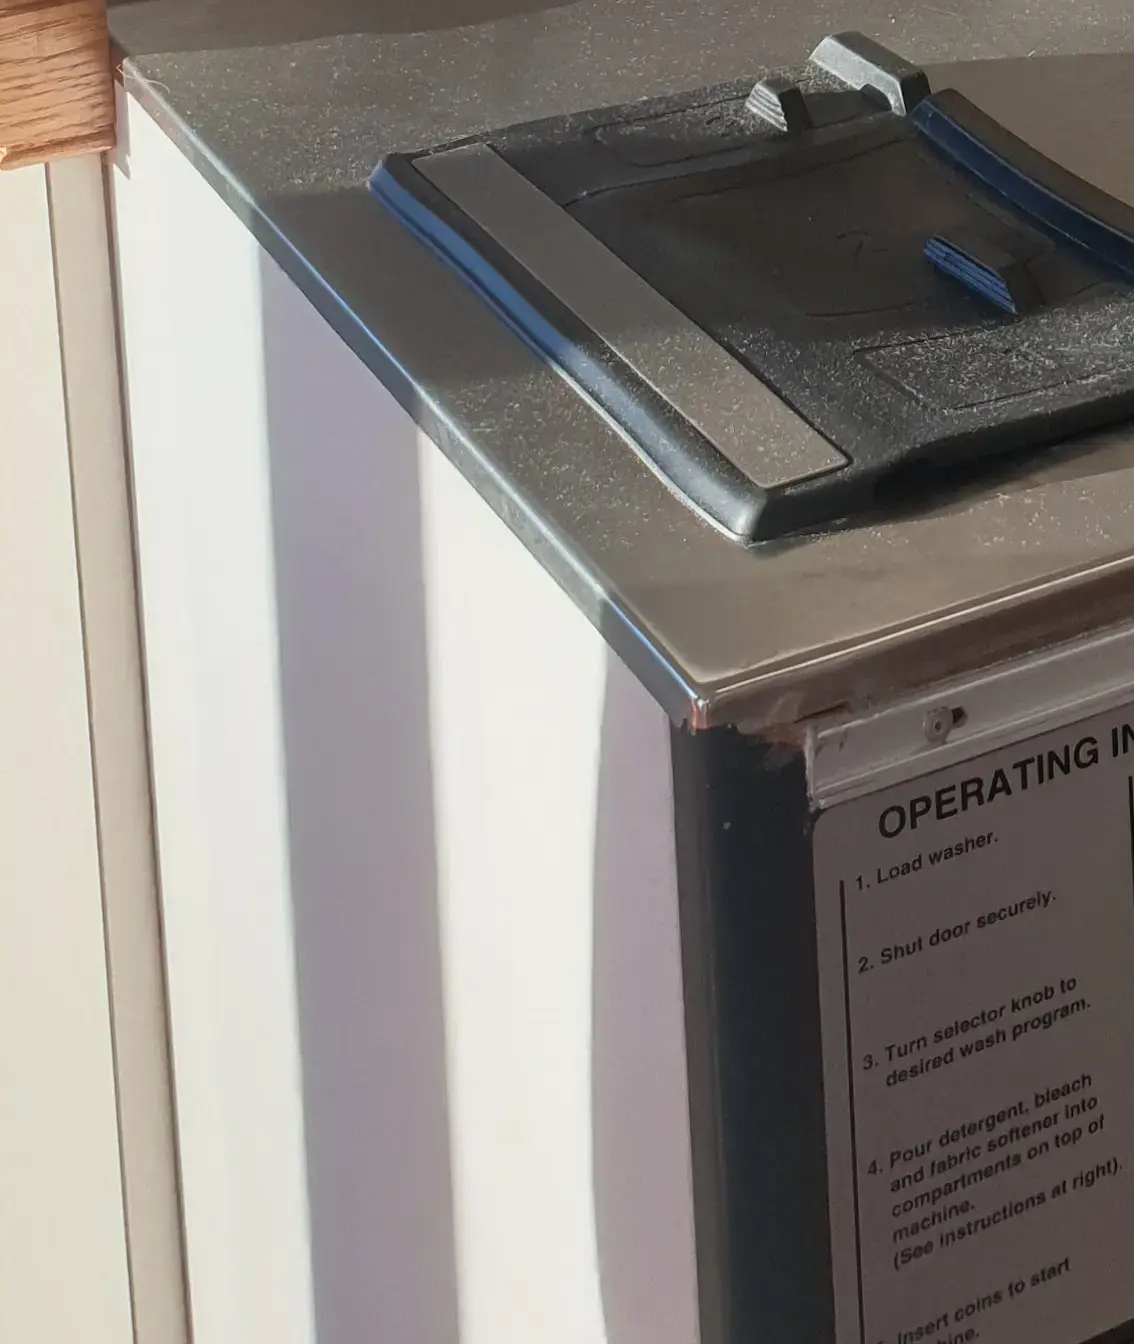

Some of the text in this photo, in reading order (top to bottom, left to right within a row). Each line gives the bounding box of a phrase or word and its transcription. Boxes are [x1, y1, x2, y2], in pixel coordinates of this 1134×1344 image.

[878, 735, 1100, 839] OPERATING
[855, 831, 999, 892] 1. Load washer.
[857, 890, 1057, 975] 2. Shut door securely.
[862, 977, 1078, 1072] 3. Turn selector knob to
[885, 997, 1092, 1088] desired wash program.
[866, 1159, 884, 1176] 4.
[889, 1139, 934, 1170] Pour
[1033, 1072, 1093, 1110] bleach
[889, 1096, 1099, 1194] and fabric softener into
[891, 1112, 1105, 1219] compartments on top of
[891, 1199, 976, 1245] machine.
[893, 1156, 1123, 1272] (See instructions at right).
[953, 1290, 1004, 1324] coins
[1007, 1279, 1027, 1299] to
[1029, 1256, 1071, 1288] start
